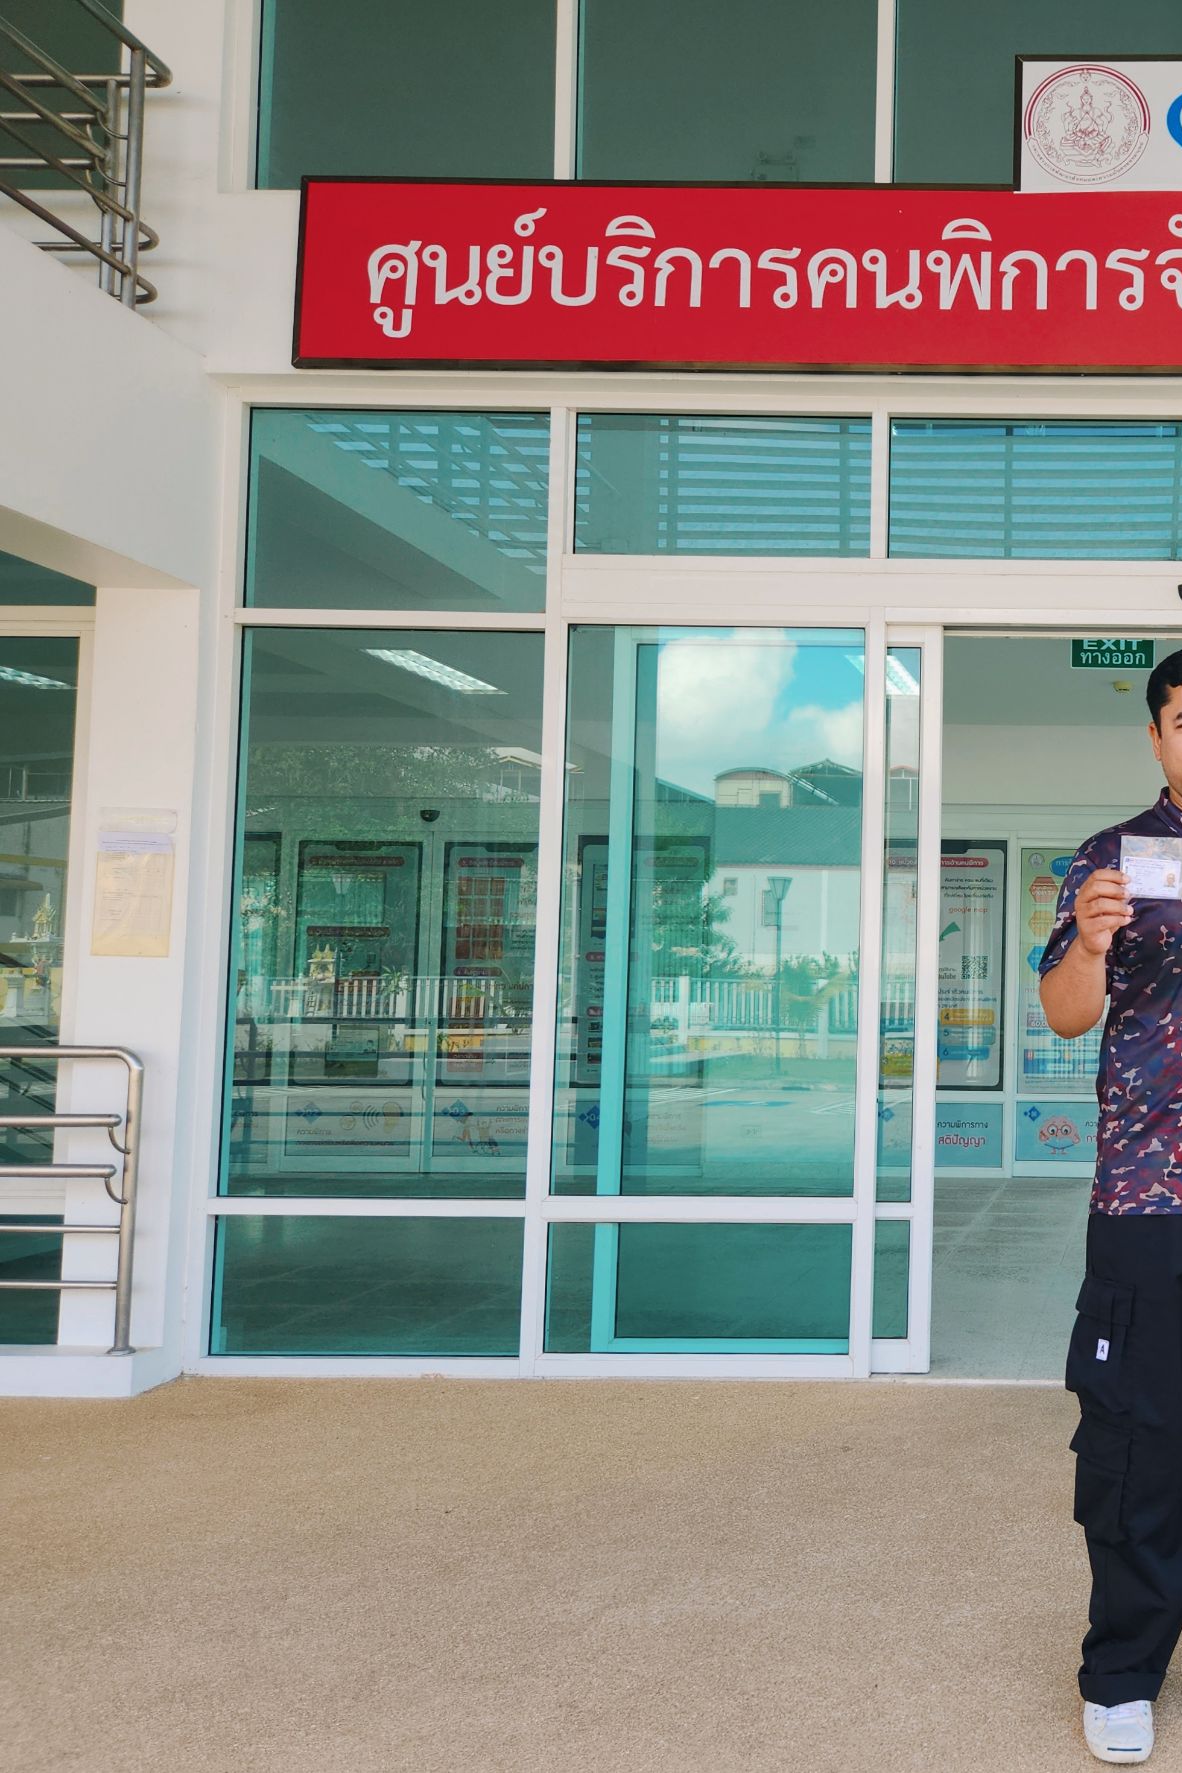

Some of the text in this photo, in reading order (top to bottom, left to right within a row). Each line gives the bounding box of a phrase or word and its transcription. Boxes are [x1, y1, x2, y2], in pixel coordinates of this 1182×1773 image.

[1083, 639, 1143, 651] EXIT
[1080, 651, 1146, 665] ทางออก
[937, 1120, 989, 1129] ความพิการทาง
[938, 1134, 986, 1148] สติปัญญา
